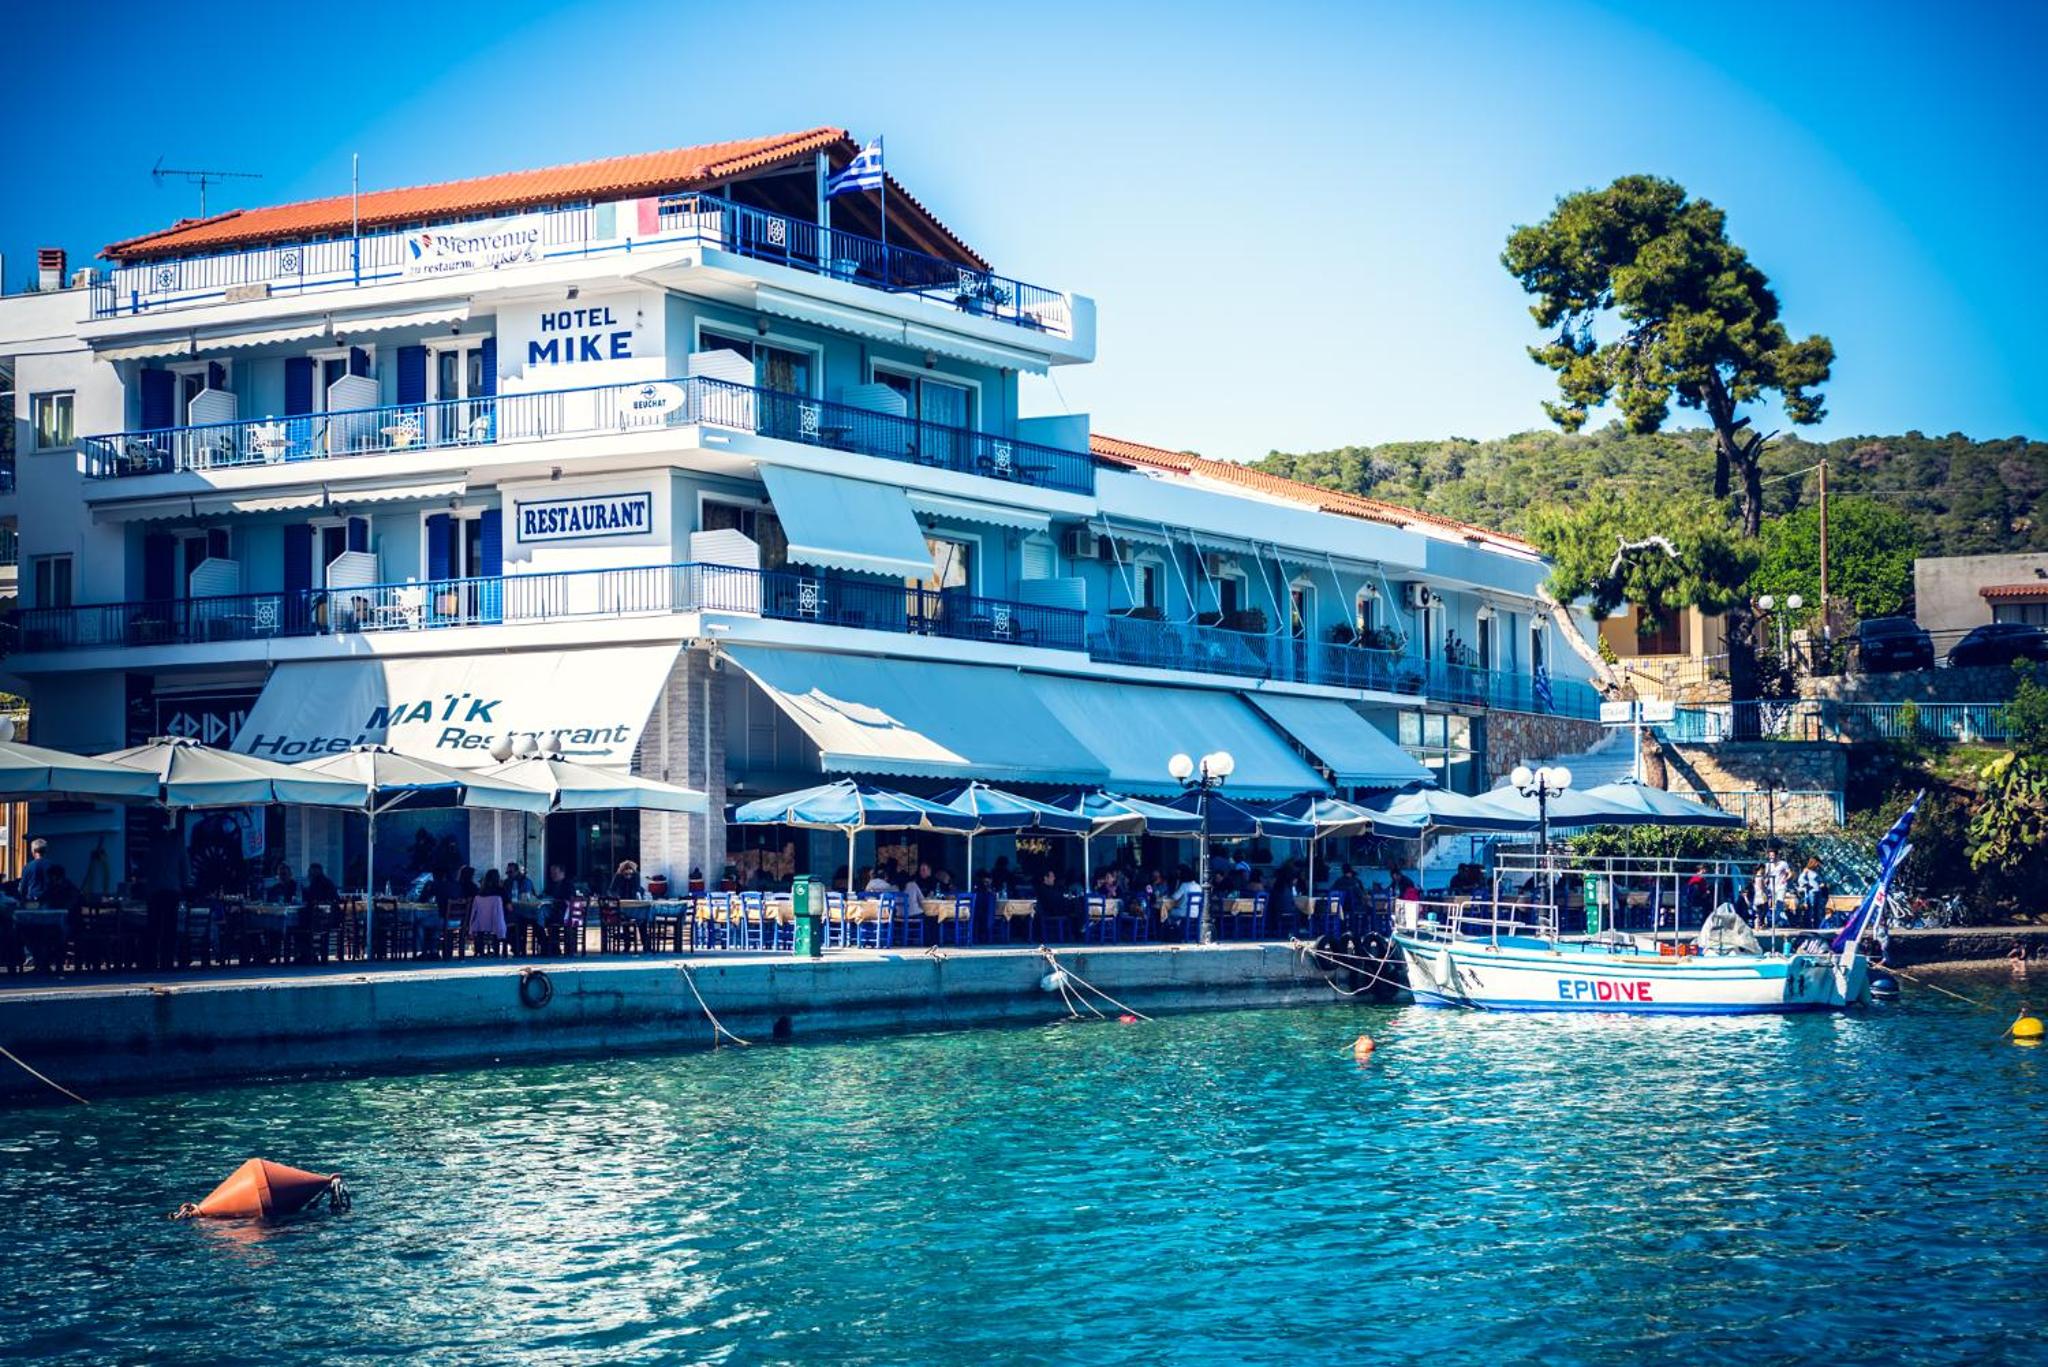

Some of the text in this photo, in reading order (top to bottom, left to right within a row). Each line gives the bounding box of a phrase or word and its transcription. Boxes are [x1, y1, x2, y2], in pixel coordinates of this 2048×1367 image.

[436, 229, 538, 256] Bienvenue
[541, 307, 617, 332] HOTEL
[528, 331, 632, 368] MIKE
[633, 399, 666, 410] BEUCHAT
[524, 501, 645, 535] RESTAURANT
[365, 693, 502, 729] MAÏK
[1558, 979, 1653, 1002] EPIDIVE
